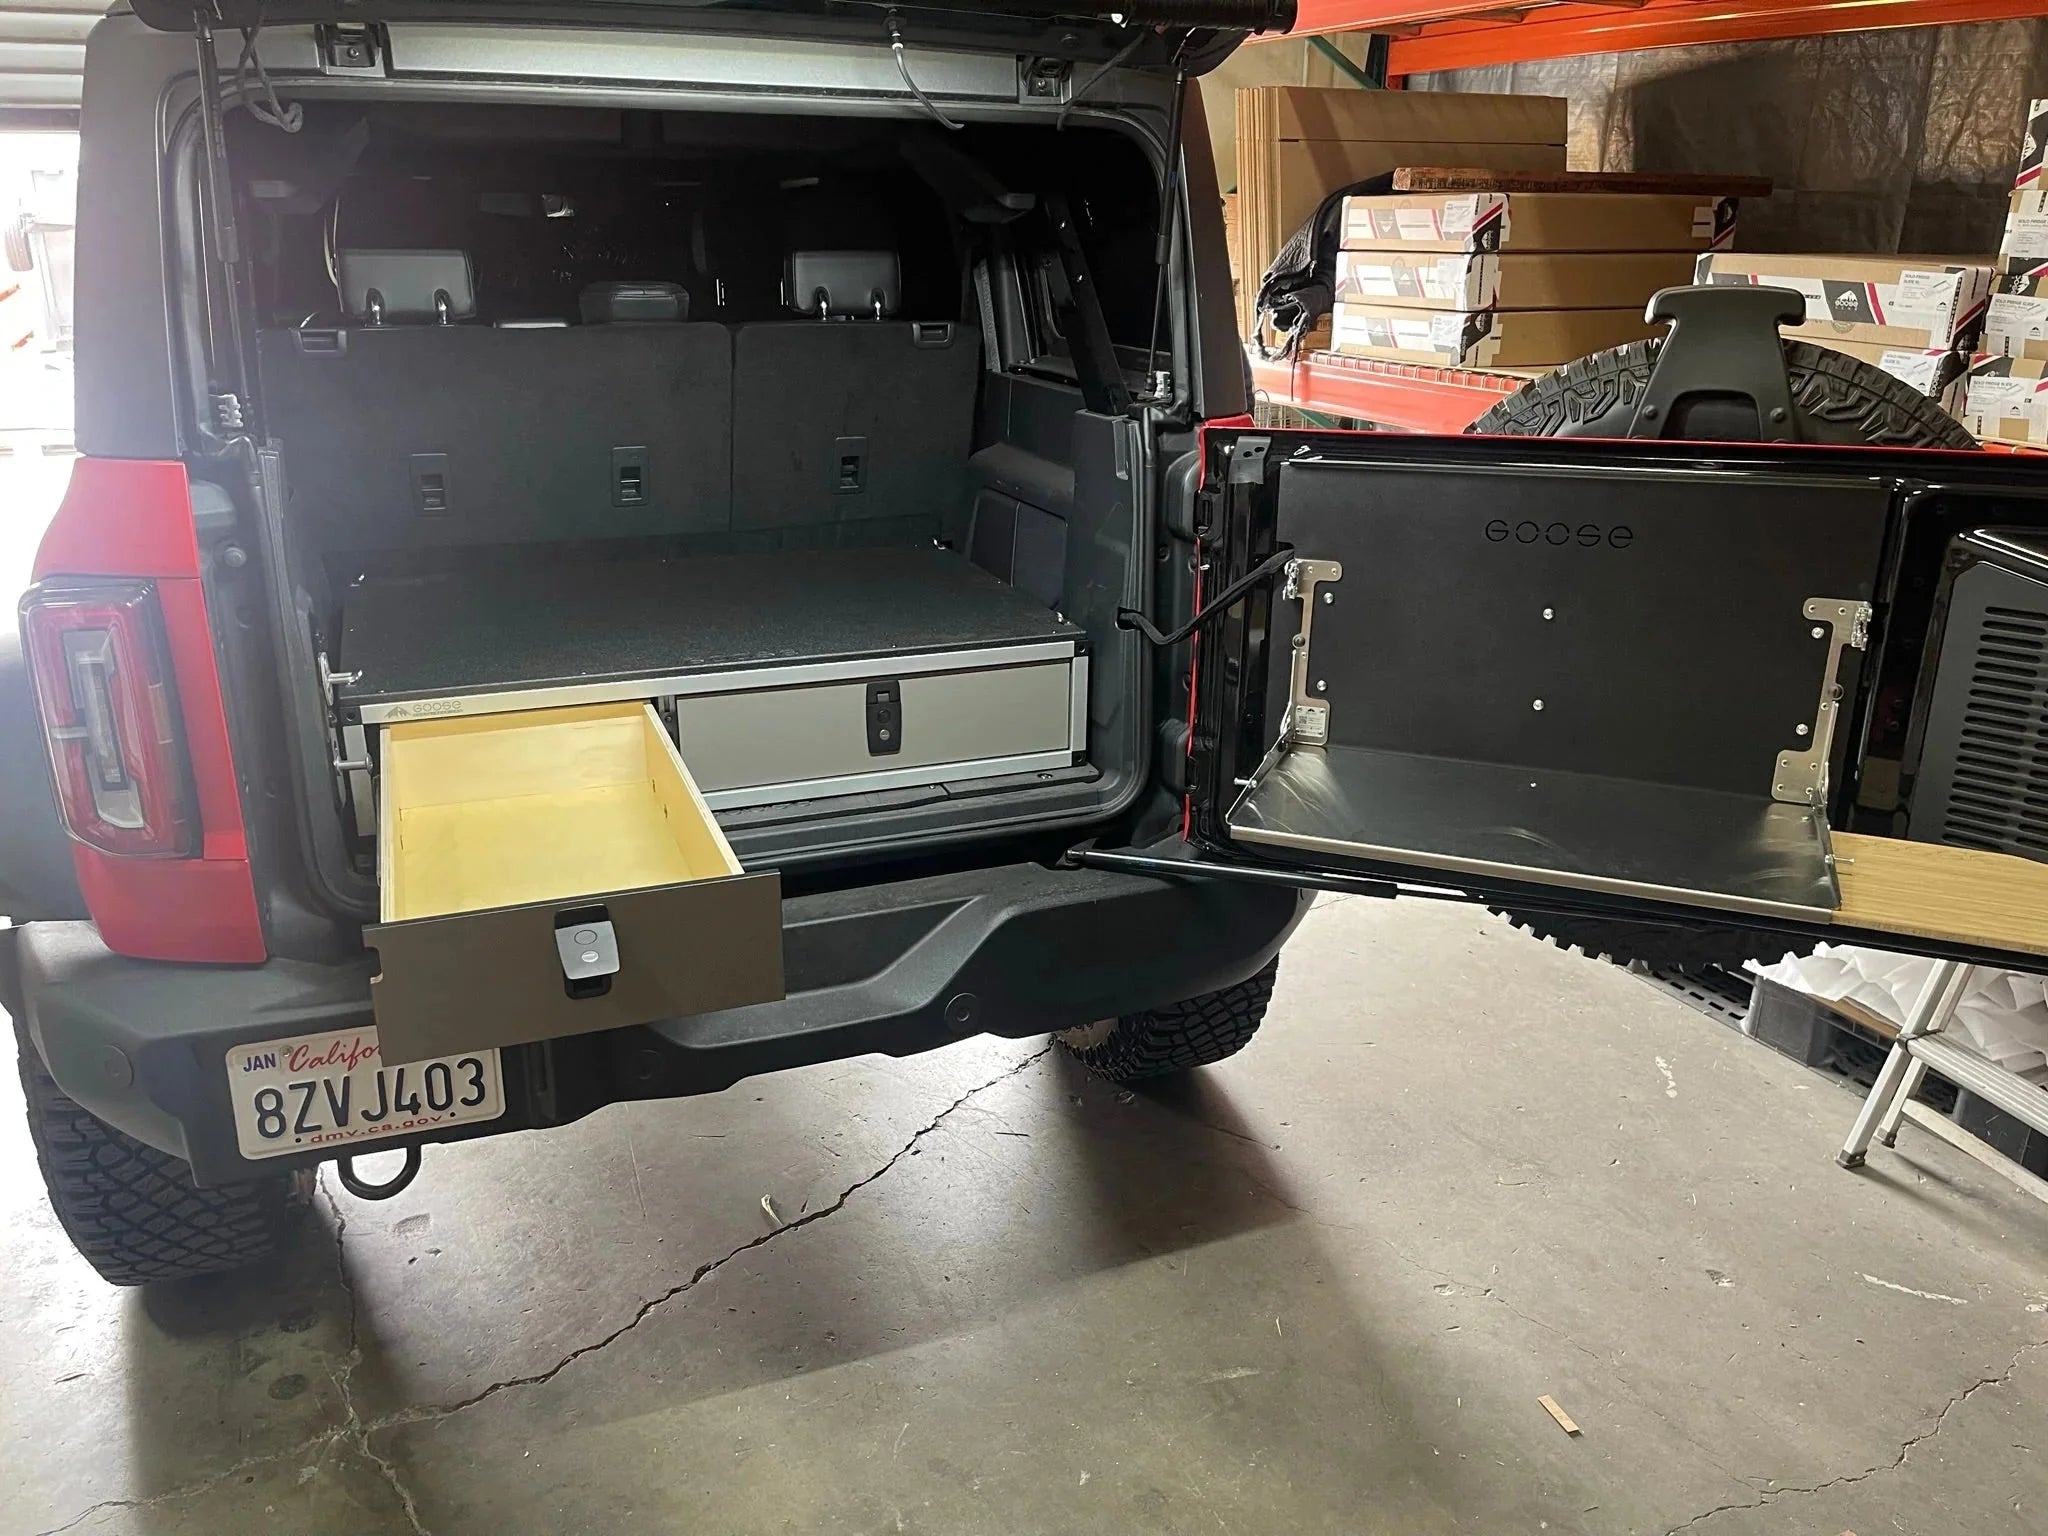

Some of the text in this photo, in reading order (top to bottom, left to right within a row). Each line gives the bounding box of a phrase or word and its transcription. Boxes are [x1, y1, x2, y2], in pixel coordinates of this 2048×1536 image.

[243, 1037, 380, 1073] JAN Califo
[253, 1057, 486, 1140] 8ZVJ403
[310, 1114, 443, 1144] dmv.ca.gov
